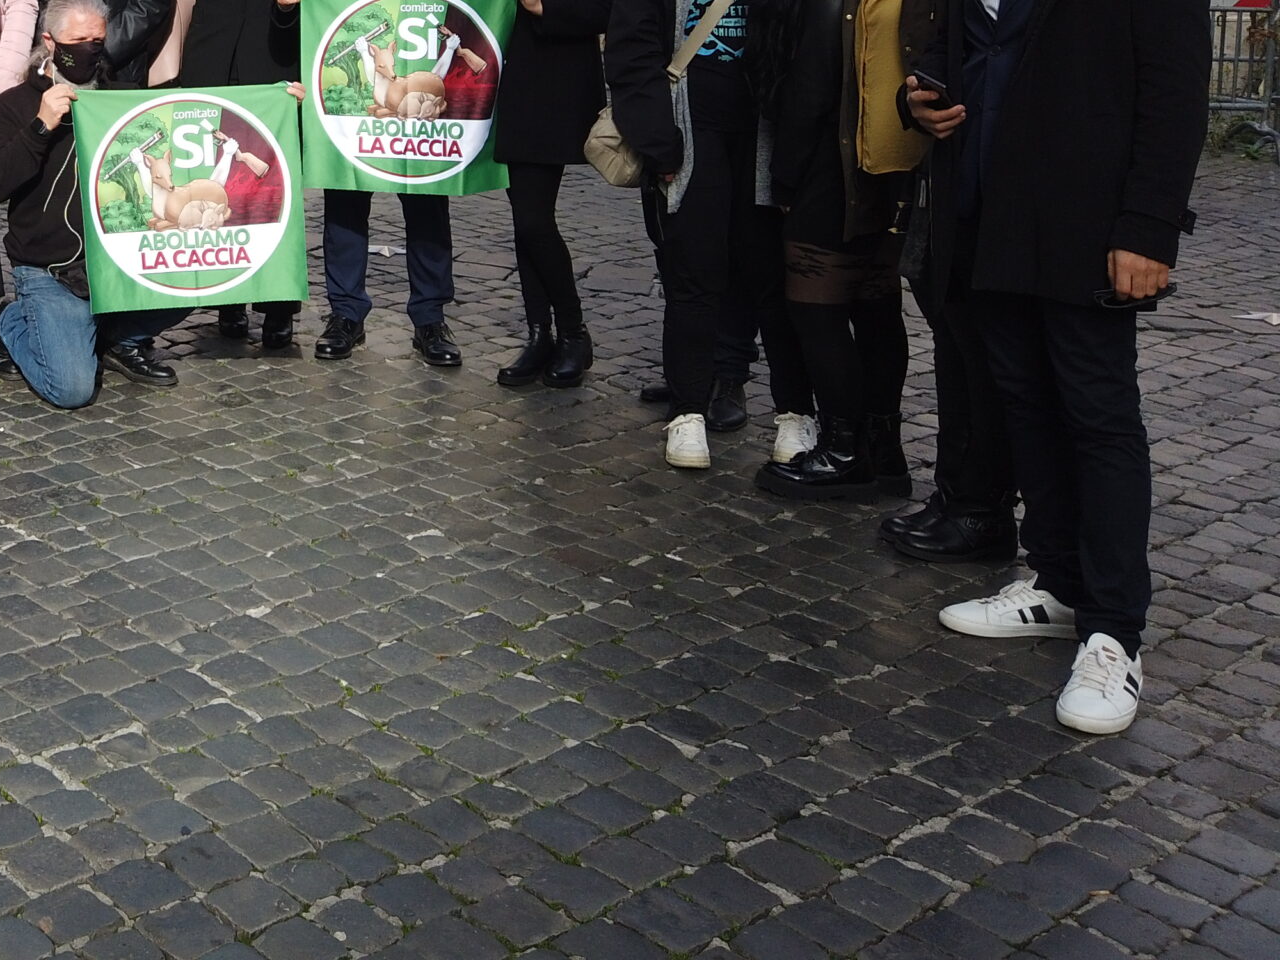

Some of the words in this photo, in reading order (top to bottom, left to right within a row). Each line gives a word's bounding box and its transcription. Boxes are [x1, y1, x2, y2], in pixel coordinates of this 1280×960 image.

[400, 2, 445, 13] comitato
[173, 107, 219, 120] comitato
[356, 120, 465, 139] ABOLIAMO
[358, 136, 386, 154] LA
[389, 138, 463, 158] CACCIA
[138, 228, 251, 252] ABOLIAMO
[141, 252, 169, 270] LA
[172, 246, 252, 268] CACCIA
